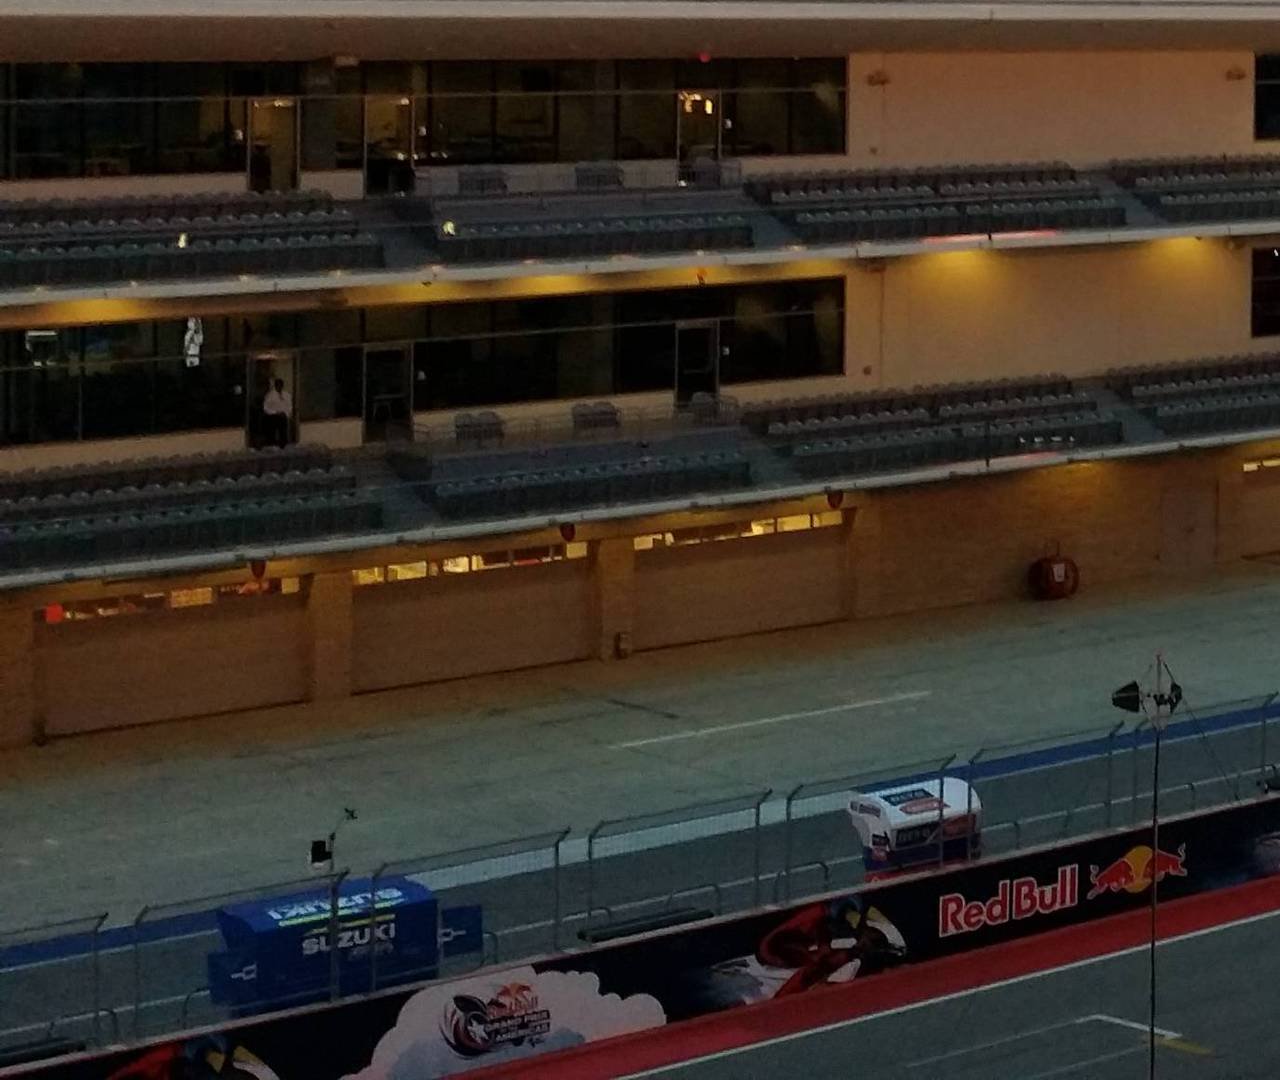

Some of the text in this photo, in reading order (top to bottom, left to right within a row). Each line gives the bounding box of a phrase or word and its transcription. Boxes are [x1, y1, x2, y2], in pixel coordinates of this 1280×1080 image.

[939, 863, 1078, 938] Red Bull
[302, 922, 396, 955] SUZUKI
